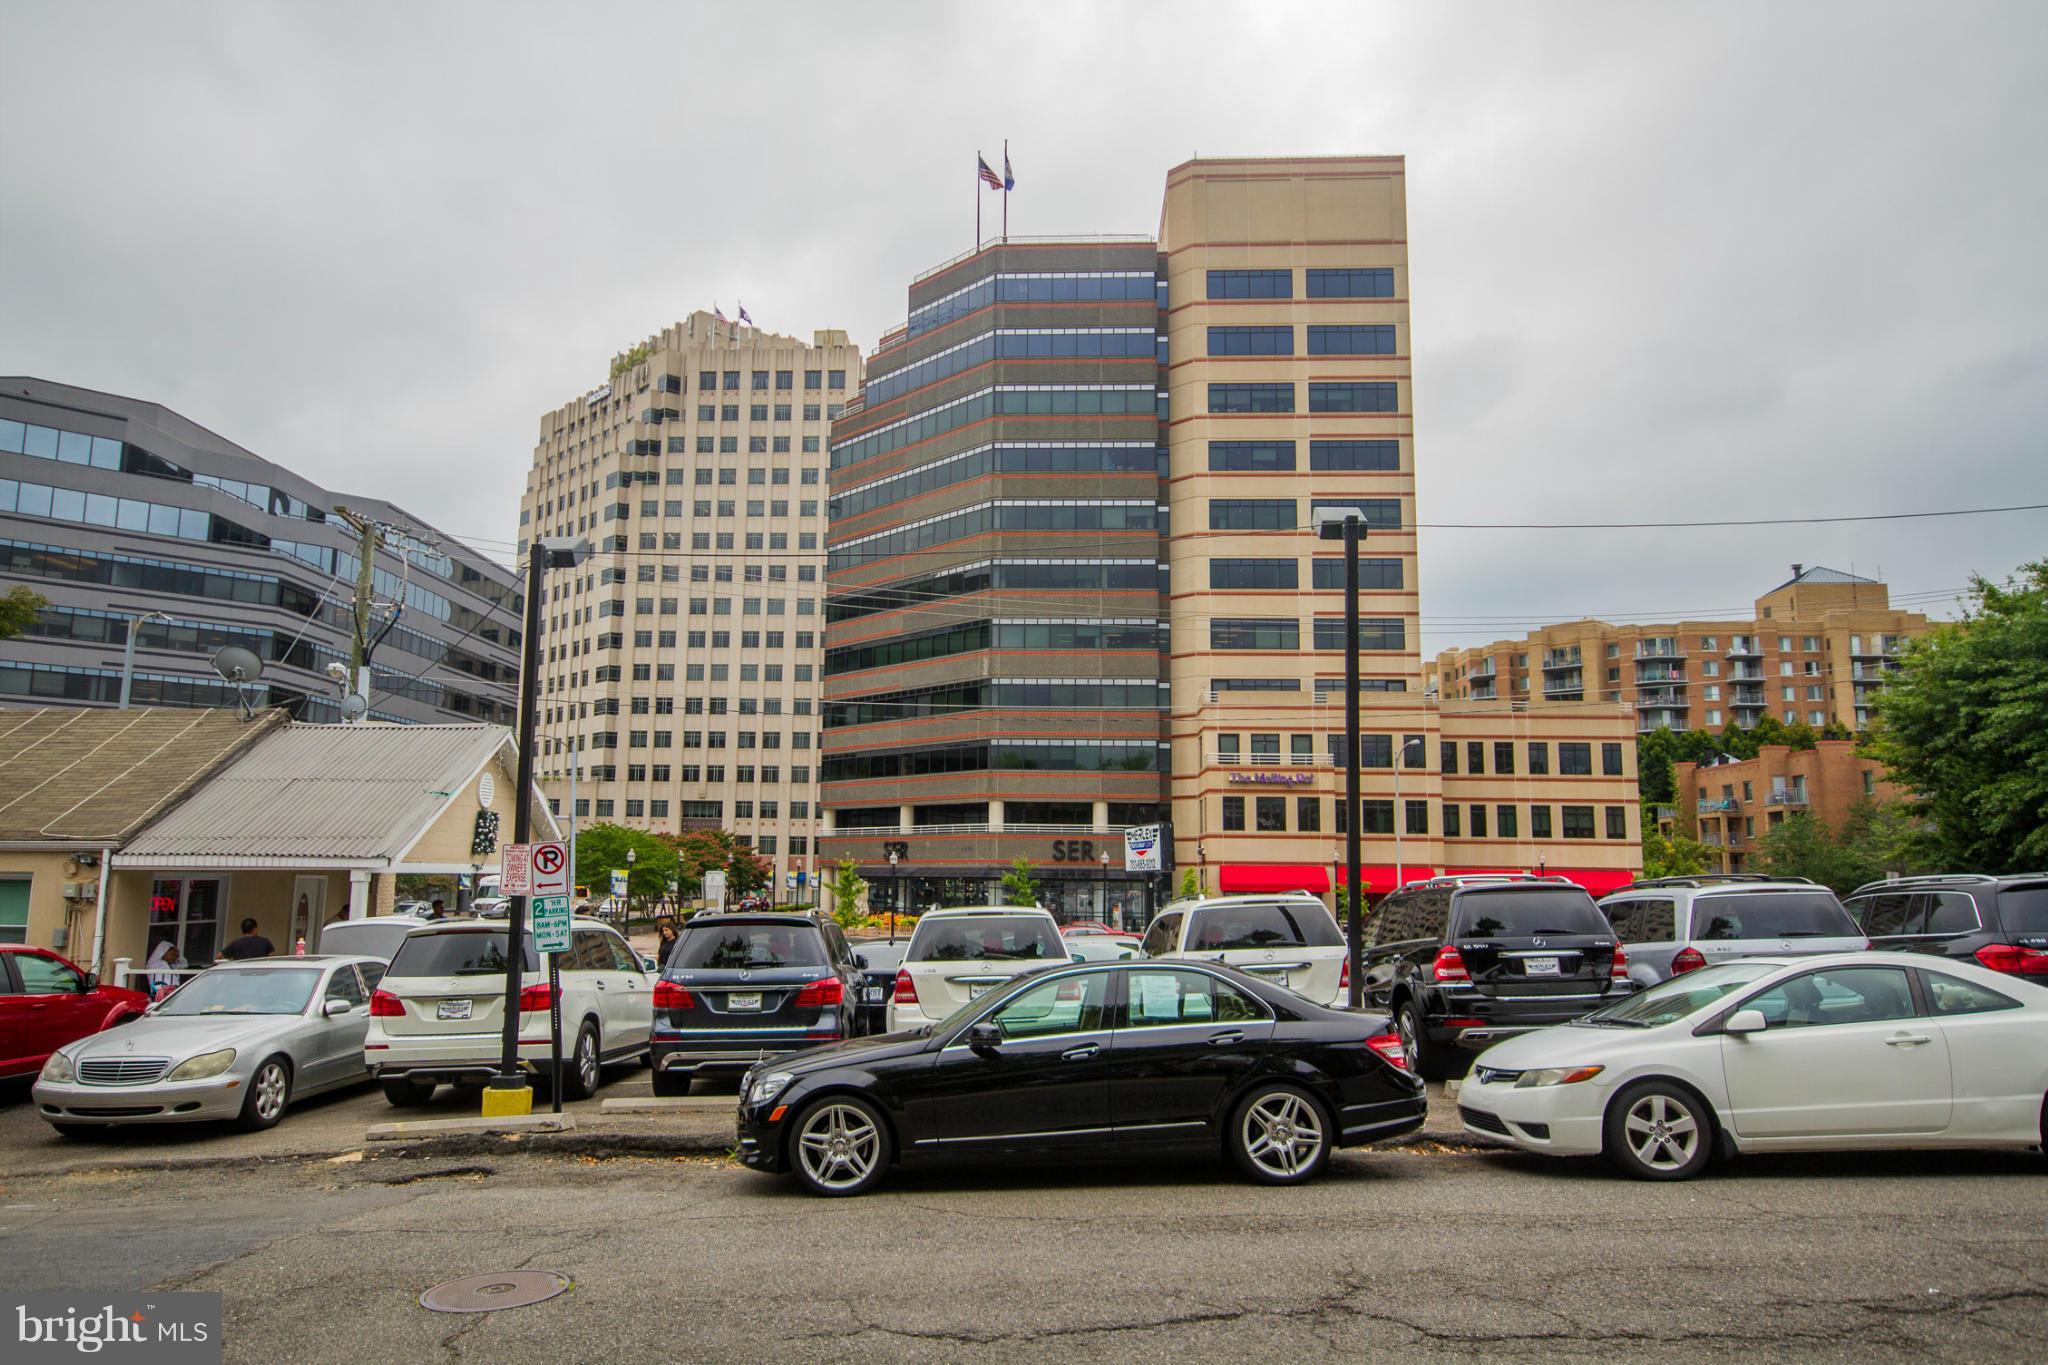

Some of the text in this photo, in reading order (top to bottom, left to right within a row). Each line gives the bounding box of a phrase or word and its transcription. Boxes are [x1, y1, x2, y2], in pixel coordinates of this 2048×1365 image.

[1052, 840, 1095, 862] SER
[506, 872, 527, 883] EXPENSE
[148, 896, 177, 912] OPEN
[535, 902, 543, 916] 2
[544, 907, 568, 915] PARKING
[536, 920, 567, 929] 8AM-6PM
[536, 930, 567, 939] MON-SAT
